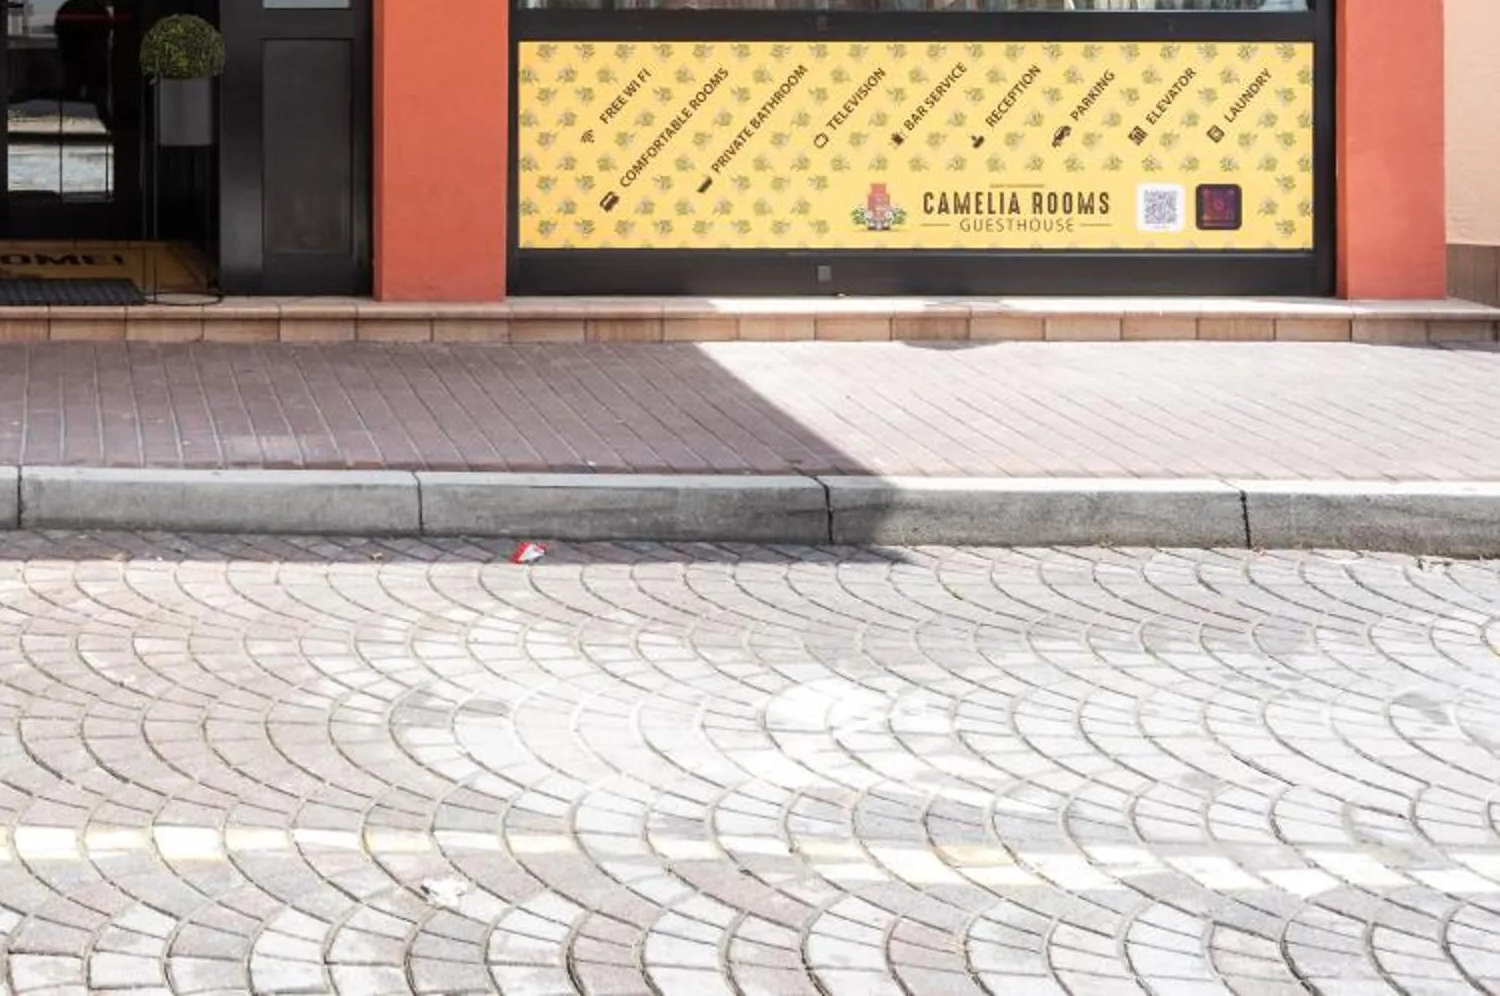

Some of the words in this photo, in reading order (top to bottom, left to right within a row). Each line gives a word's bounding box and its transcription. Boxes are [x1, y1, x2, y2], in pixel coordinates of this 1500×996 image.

[599, 95, 628, 124] FREE
[622, 79, 641, 97] WI
[637, 67, 652, 83] FI
[710, 126, 754, 174] PRIVATE
[749, 64, 809, 130] BATHROOM
[826, 67, 887, 131] TELEVISION
[903, 105, 928, 131] BAR
[924, 61, 967, 109] SERVICE
[985, 64, 1041, 128] RECEPTION
[1069, 68, 1116, 122] PARKING
[1145, 67, 1197, 125] ELEVATOR
[1223, 67, 1272, 123] LAUNDRY
[619, 107, 693, 188] COMFORTABLE
[688, 67, 729, 111] ROOMS
[923, 191, 1021, 215] CAMELIA
[1032, 191, 1110, 215] ROOMS
[959, 218, 1074, 232] GUESTHOUSE
